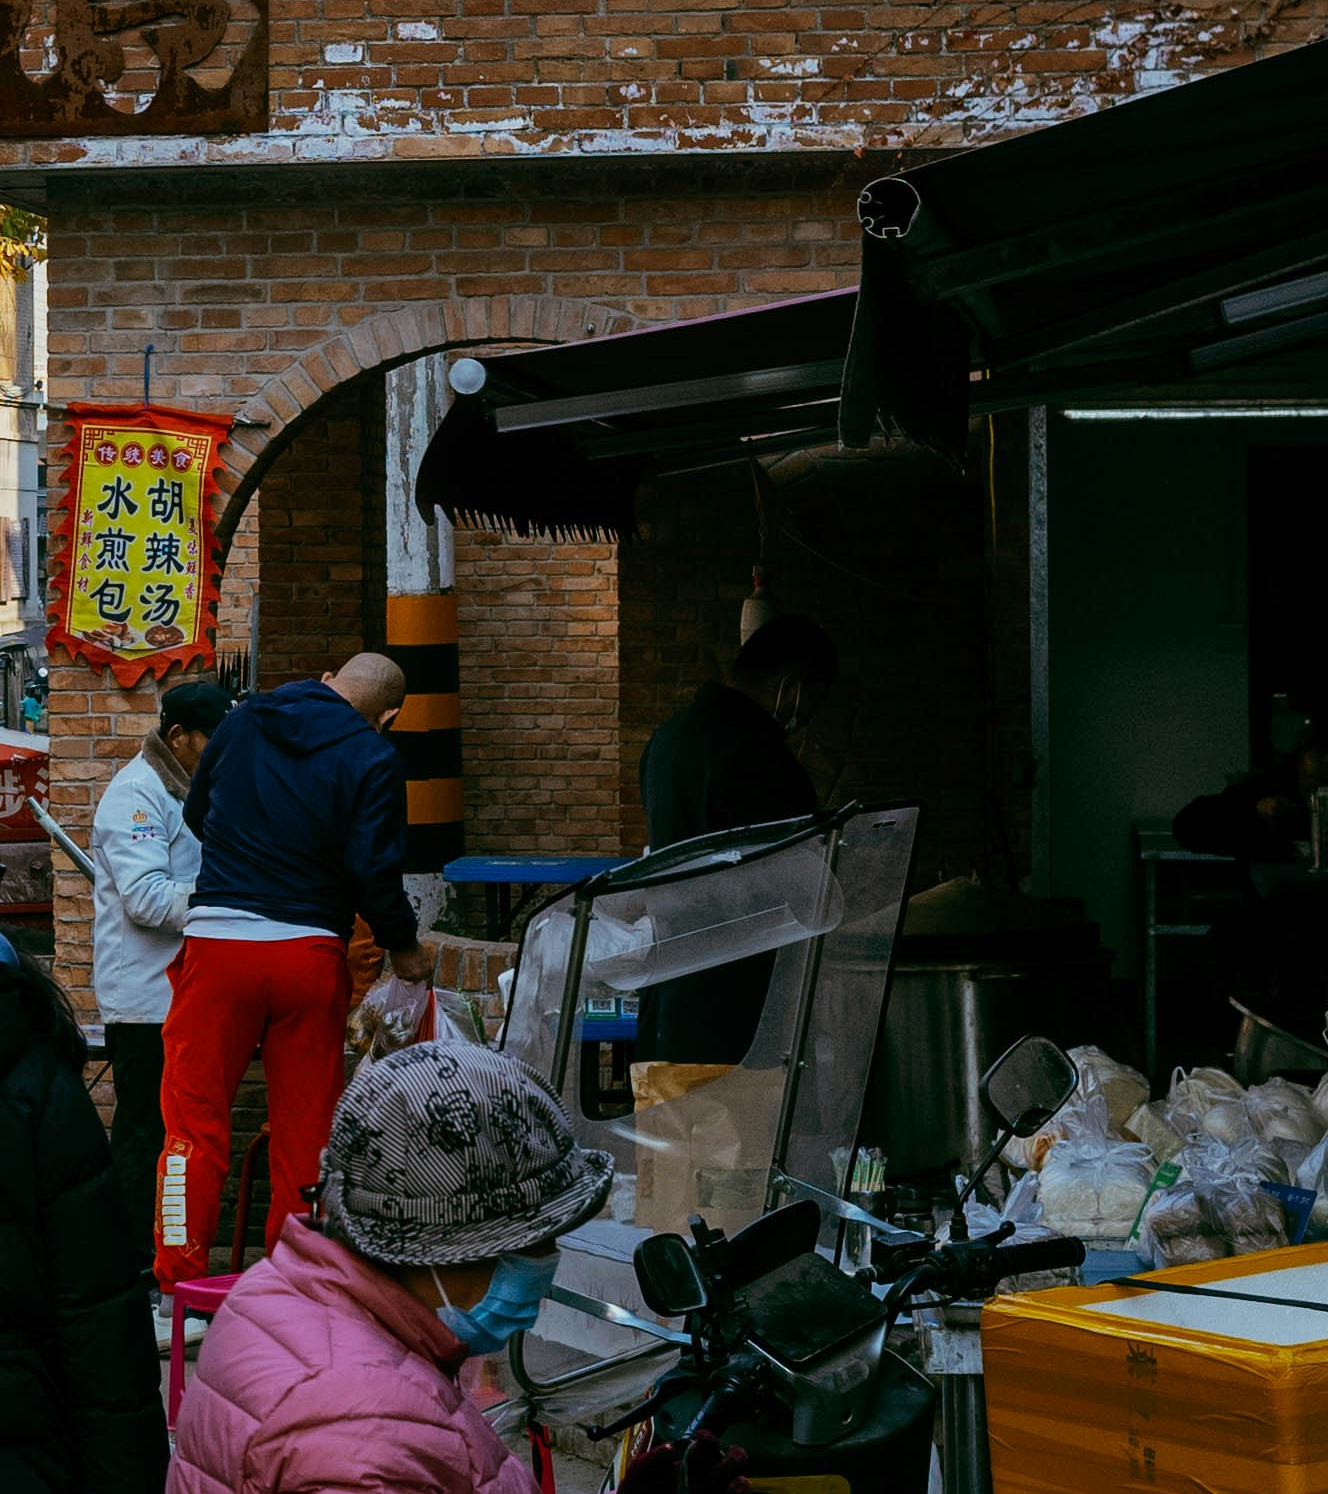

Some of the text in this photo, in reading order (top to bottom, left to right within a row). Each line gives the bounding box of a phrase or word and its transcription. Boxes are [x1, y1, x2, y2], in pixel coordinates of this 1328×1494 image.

[97, 446, 192, 468] 传统美食
[89, 476, 139, 624] 水煎包
[140, 477, 185, 627] 胡辣汤
